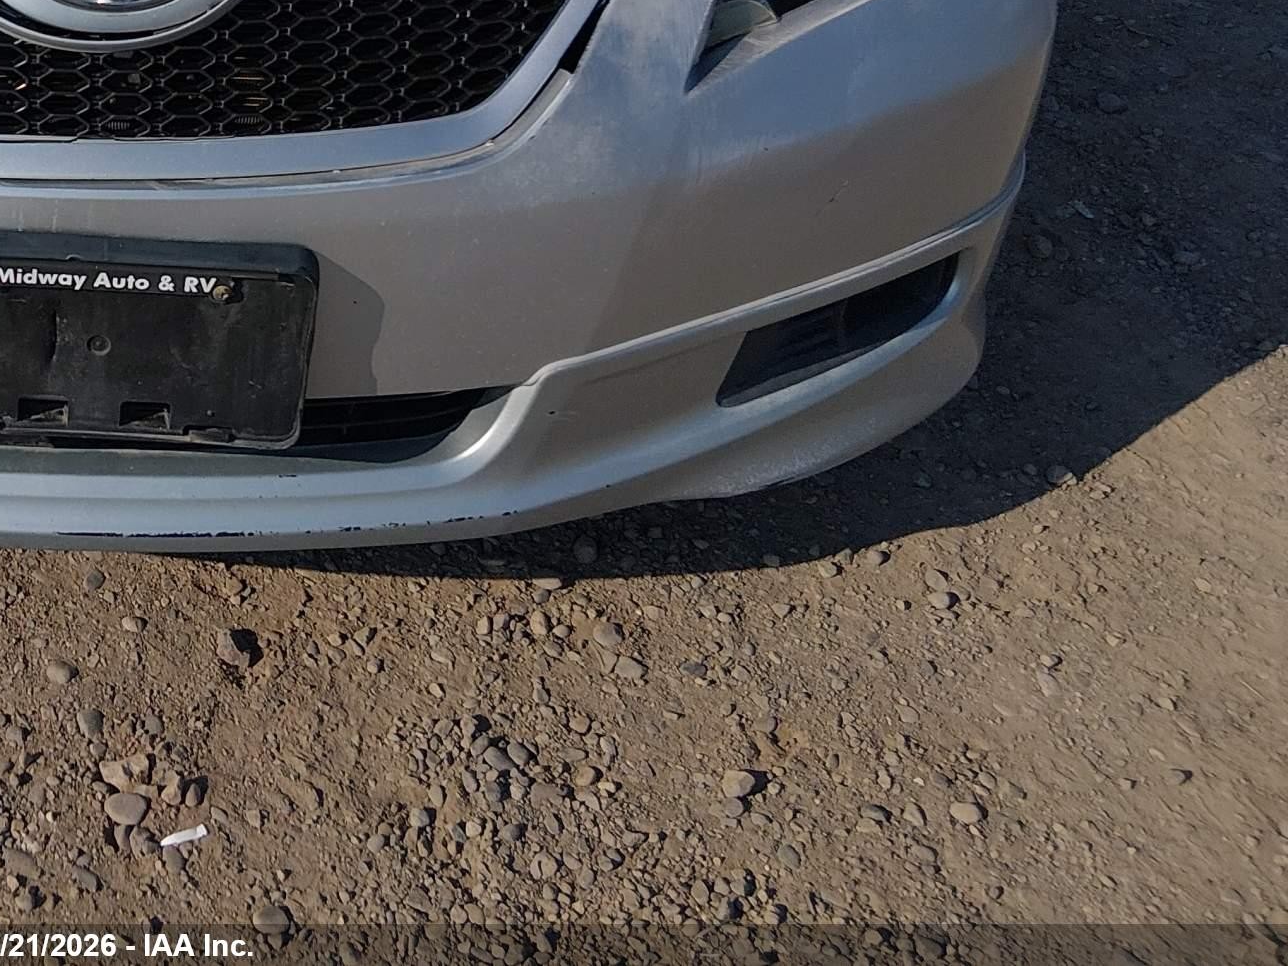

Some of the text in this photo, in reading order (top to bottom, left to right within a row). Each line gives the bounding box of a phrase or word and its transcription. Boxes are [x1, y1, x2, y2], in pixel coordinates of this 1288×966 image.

[93, 271, 150, 291] Auto
[158, 274, 175, 292] &
[184, 276, 217, 294] RV
